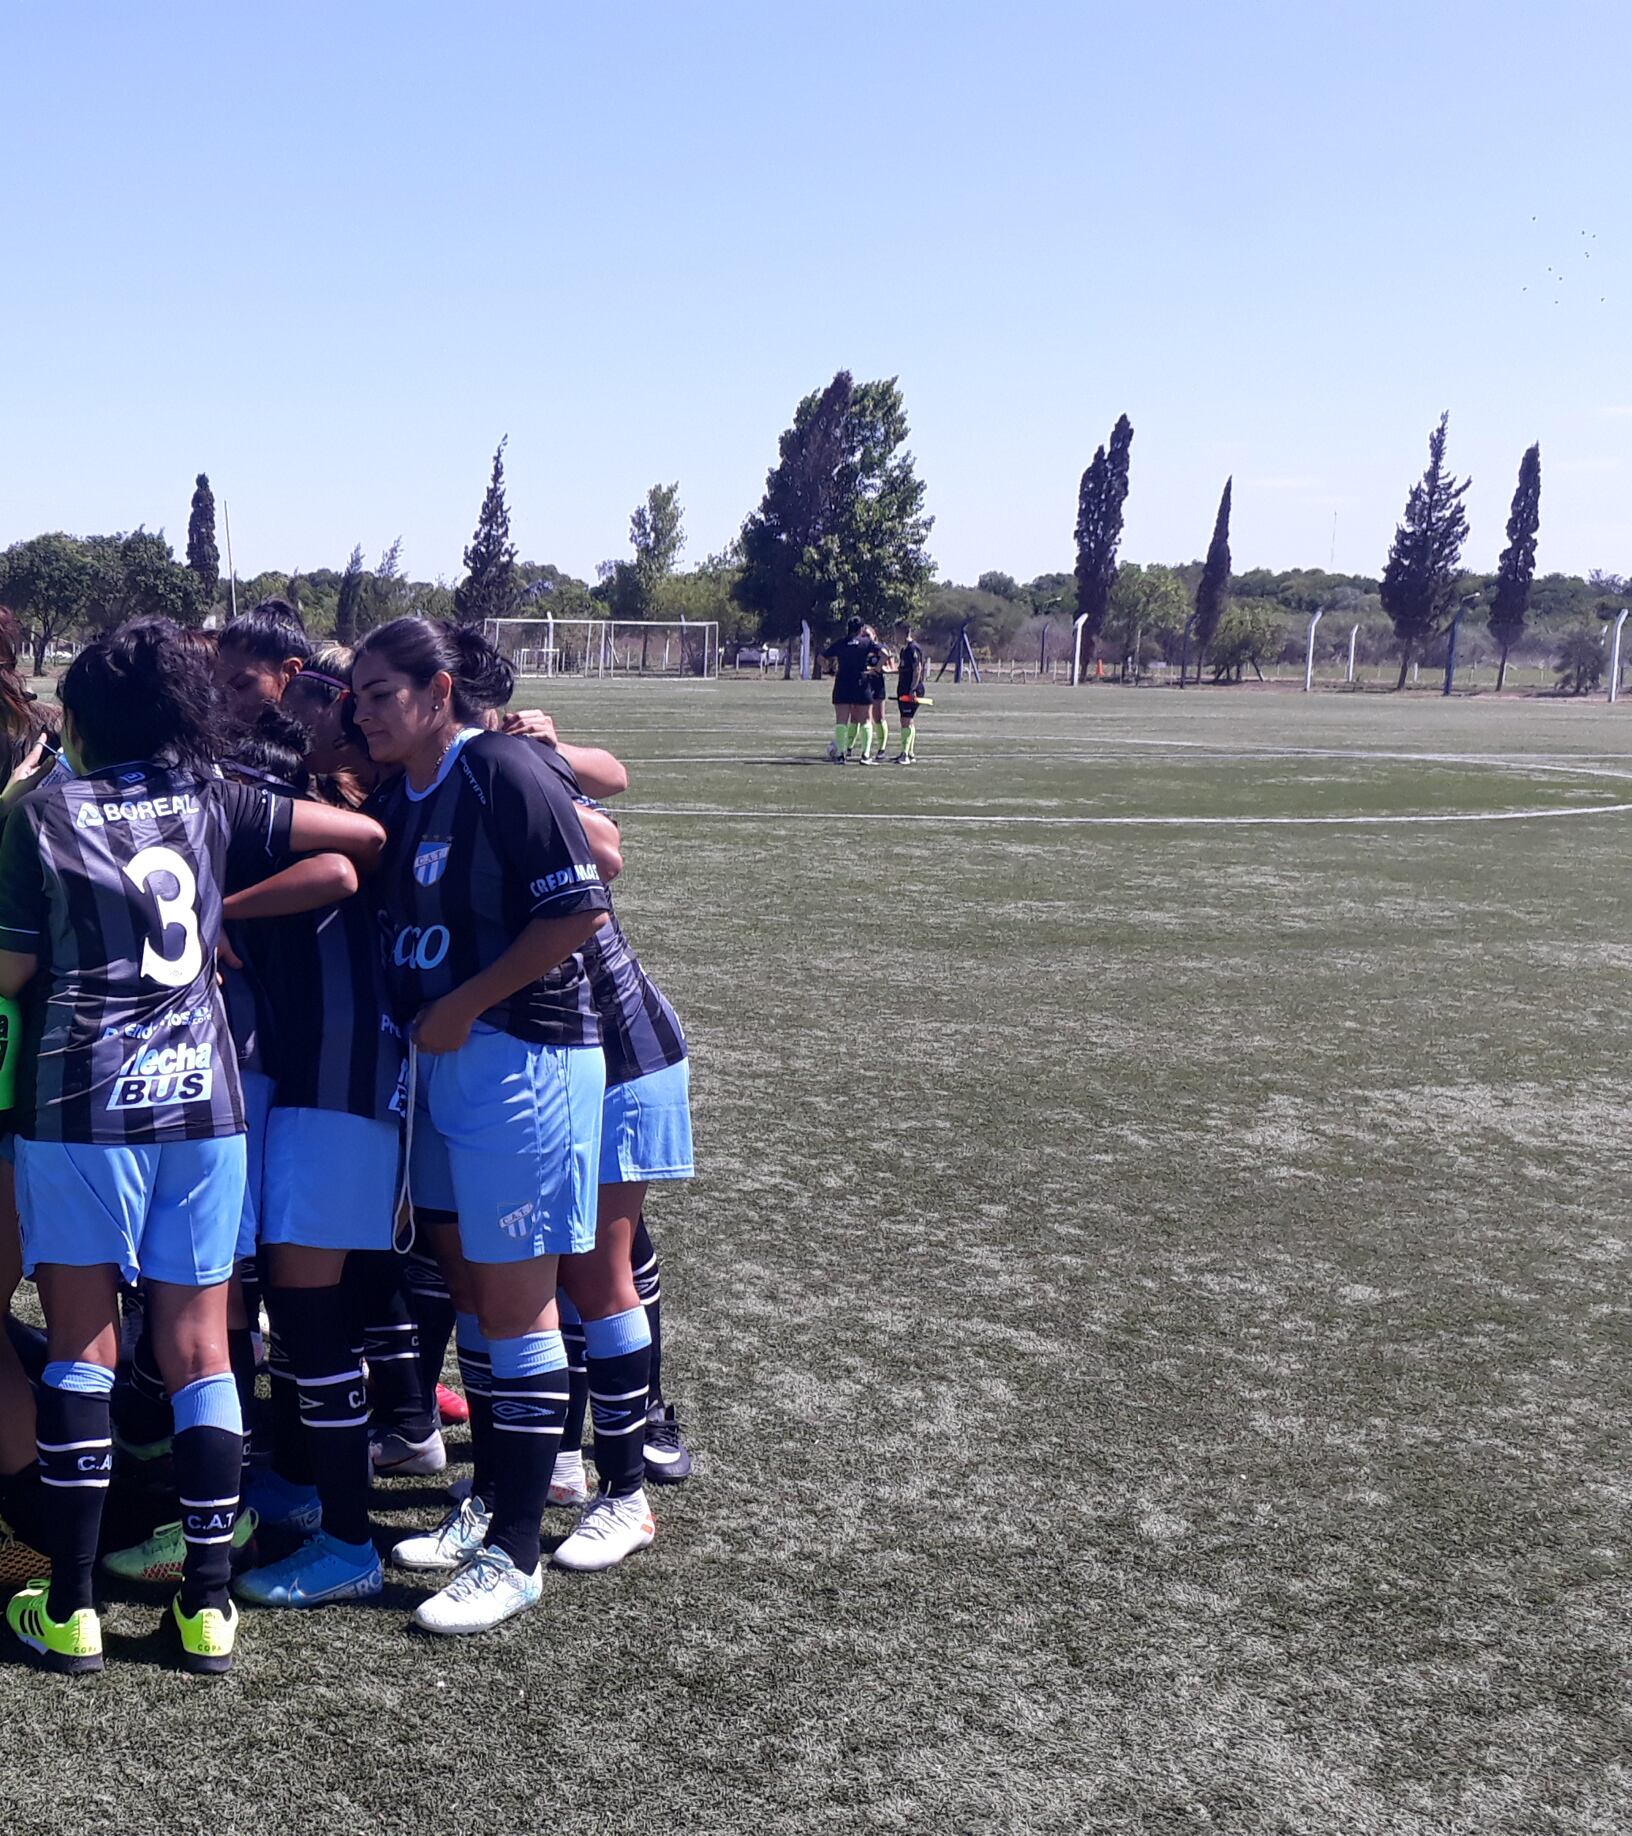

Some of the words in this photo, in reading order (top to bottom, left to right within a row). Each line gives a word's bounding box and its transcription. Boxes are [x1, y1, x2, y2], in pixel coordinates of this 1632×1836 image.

[103, 793, 200, 822] BOREAL
[122, 845, 203, 987] 3
[115, 1072, 205, 1106] BUS
